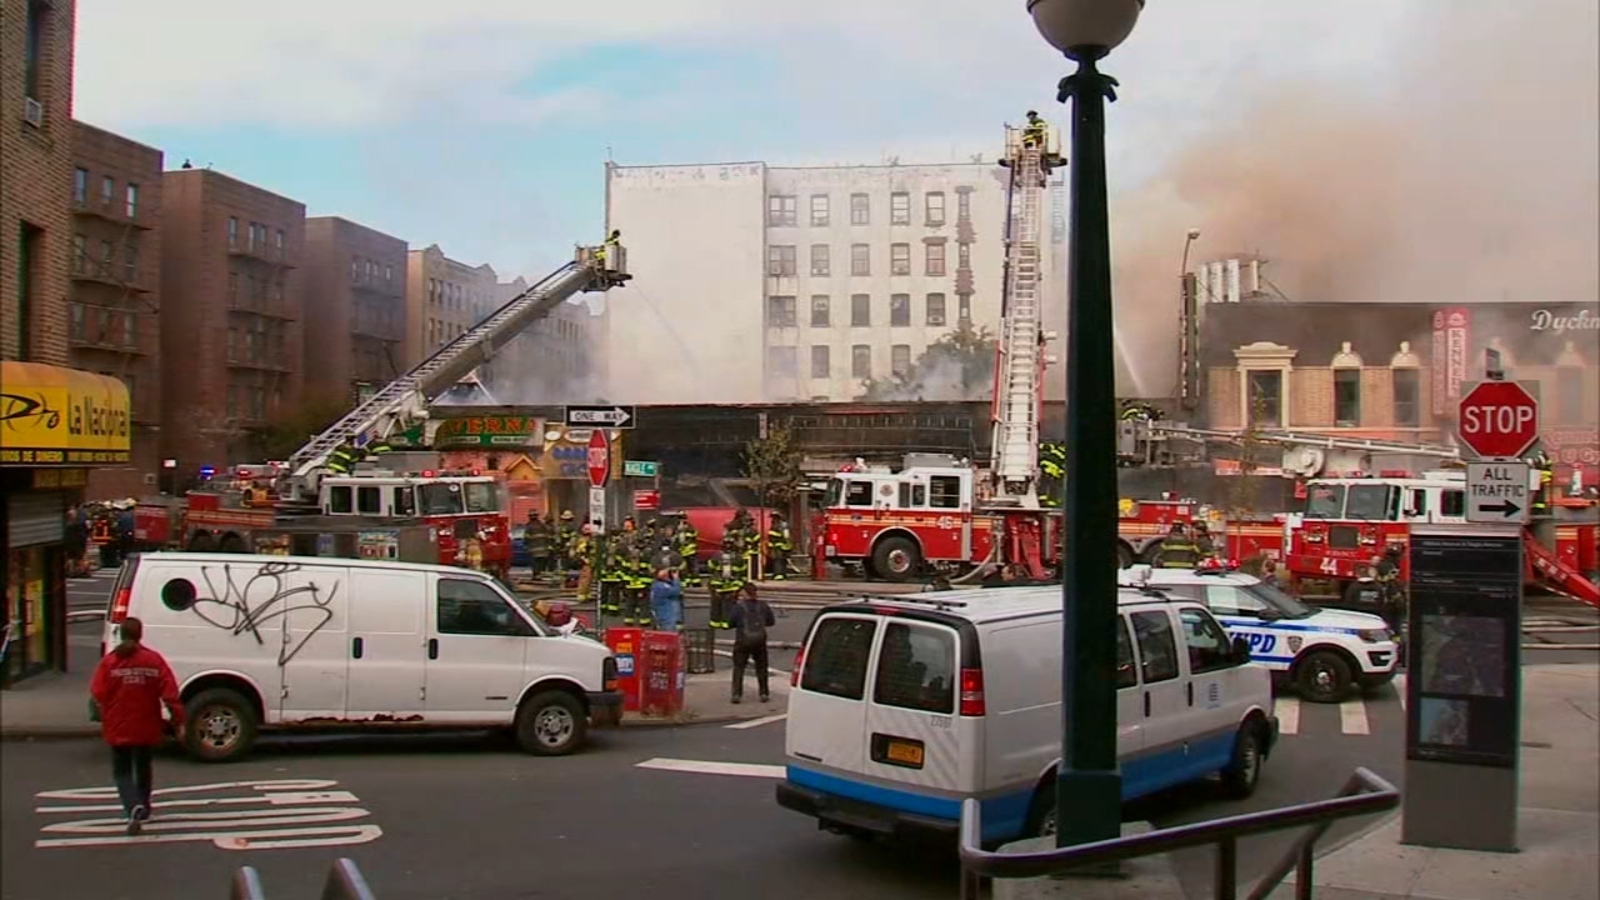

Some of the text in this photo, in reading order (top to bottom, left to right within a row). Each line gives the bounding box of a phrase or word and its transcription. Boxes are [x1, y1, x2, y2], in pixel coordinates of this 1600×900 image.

[574, 411, 624, 421] ONE WAY
[1464, 406, 1533, 433] STOP
[1483, 468, 1513, 481] ALL
[1471, 485, 1524, 498] TRAFFIC
[1319, 556, 1338, 576] 44
[1229, 631, 1276, 653] PD
